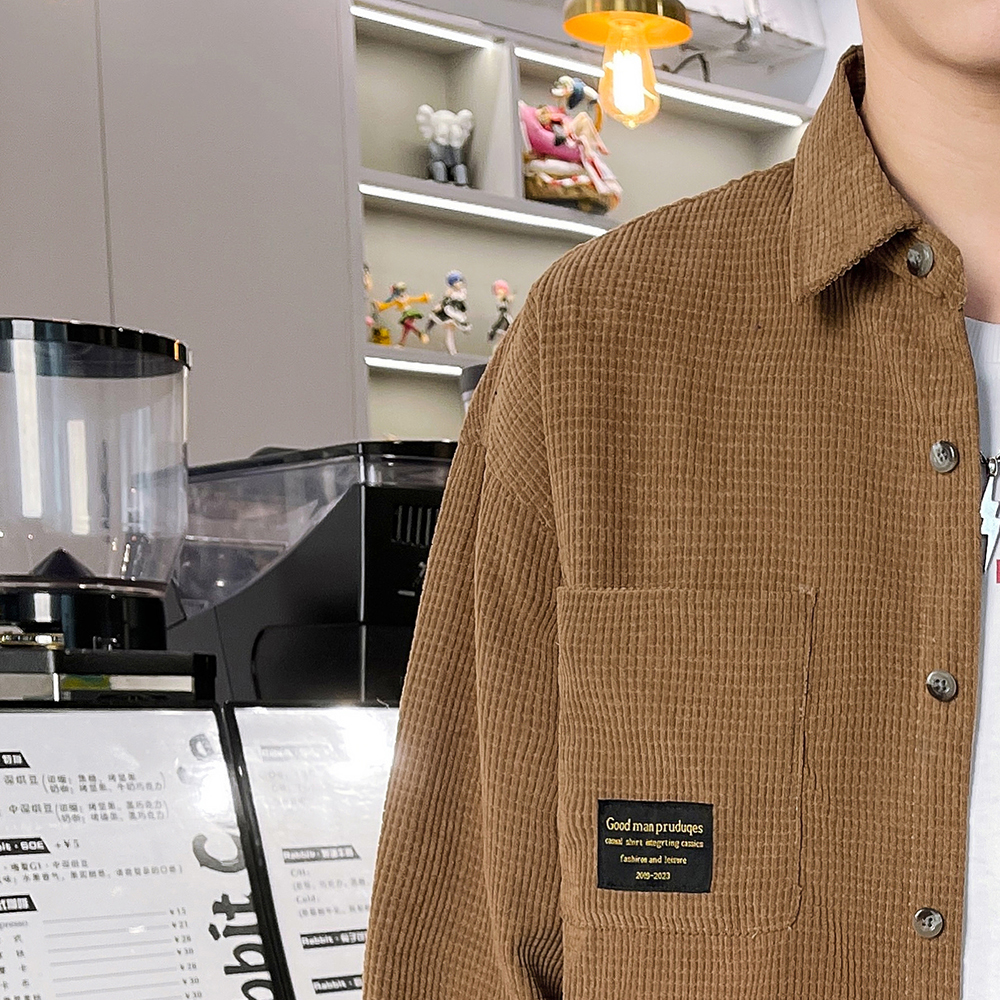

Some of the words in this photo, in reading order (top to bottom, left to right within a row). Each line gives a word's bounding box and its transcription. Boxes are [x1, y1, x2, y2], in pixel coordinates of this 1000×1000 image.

[606, 816, 631, 831] Good
[632, 822, 654, 832] man
[648, 855, 662, 864] and
[635, 872, 671, 880] 2019-2023
